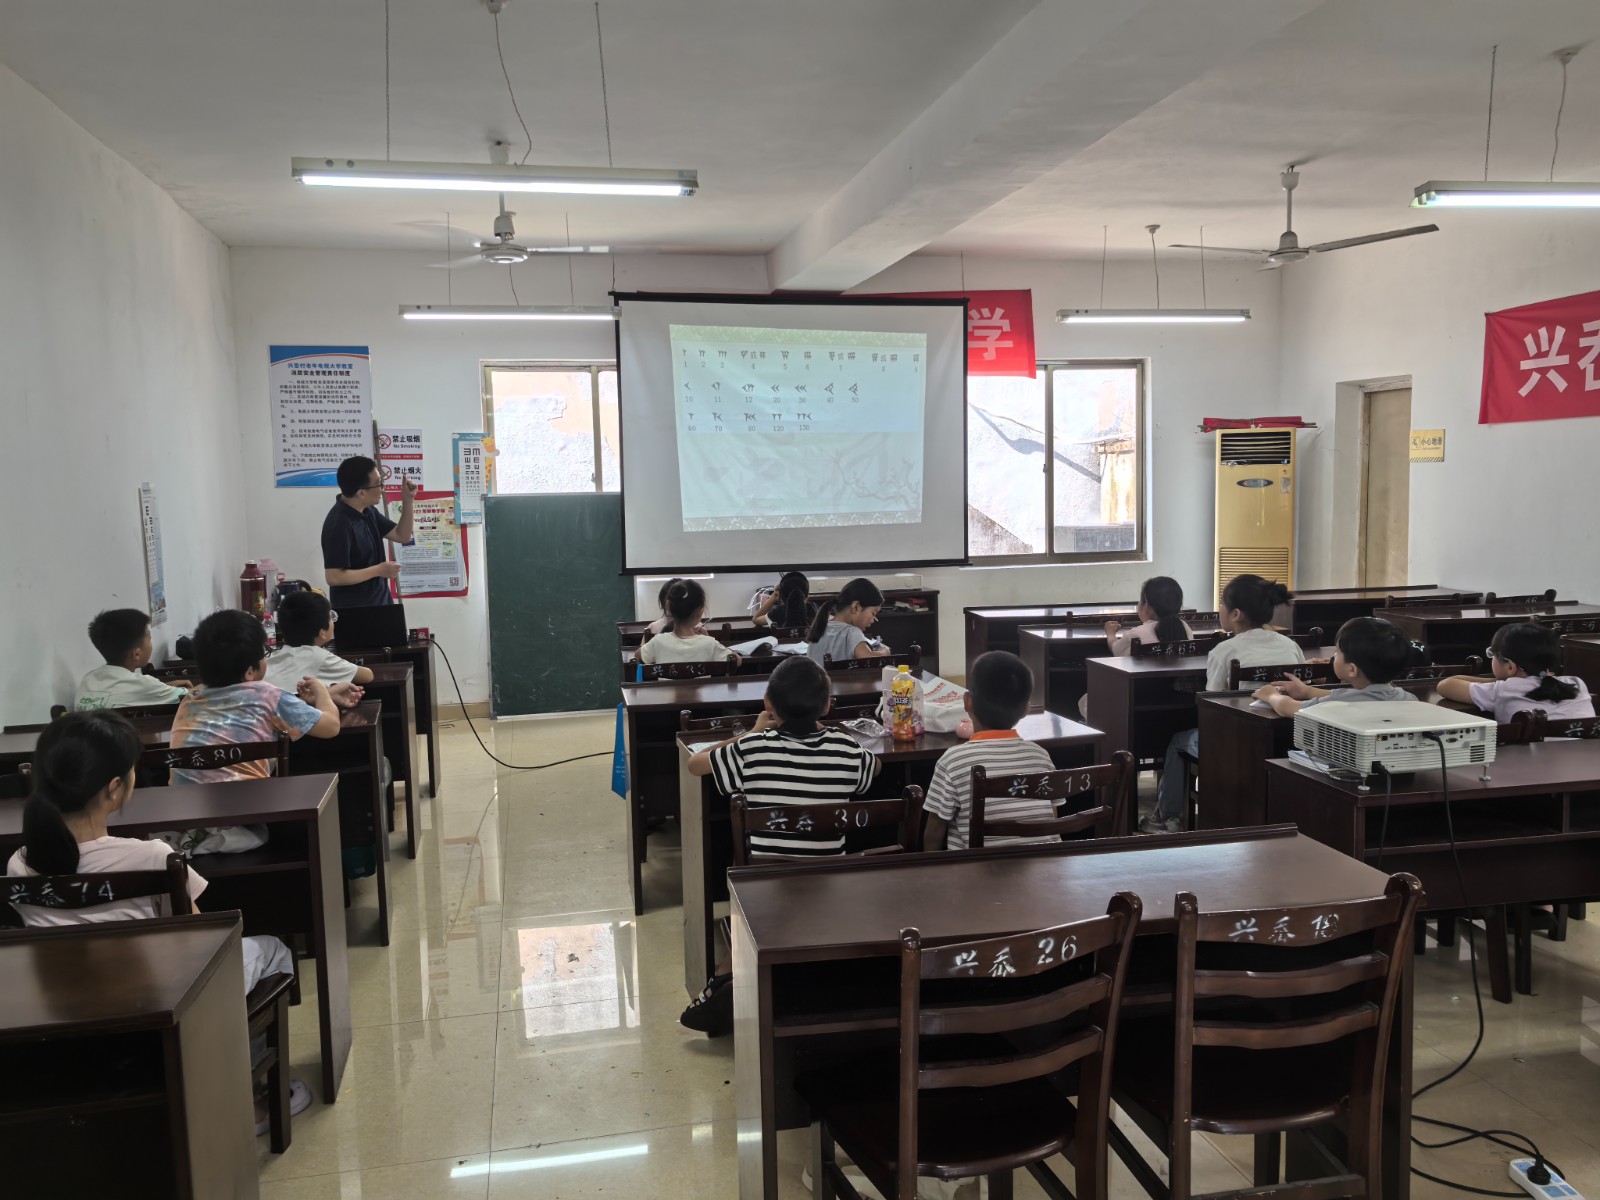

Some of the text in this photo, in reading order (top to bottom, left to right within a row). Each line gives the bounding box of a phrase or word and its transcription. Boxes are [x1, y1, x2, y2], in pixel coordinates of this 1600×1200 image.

[968, 307, 1014, 361] 学
[773, 396, 781, 404] 20
[392, 435, 421, 443] 禁止吸烟
[394, 466, 422, 475] 禁止烟火
